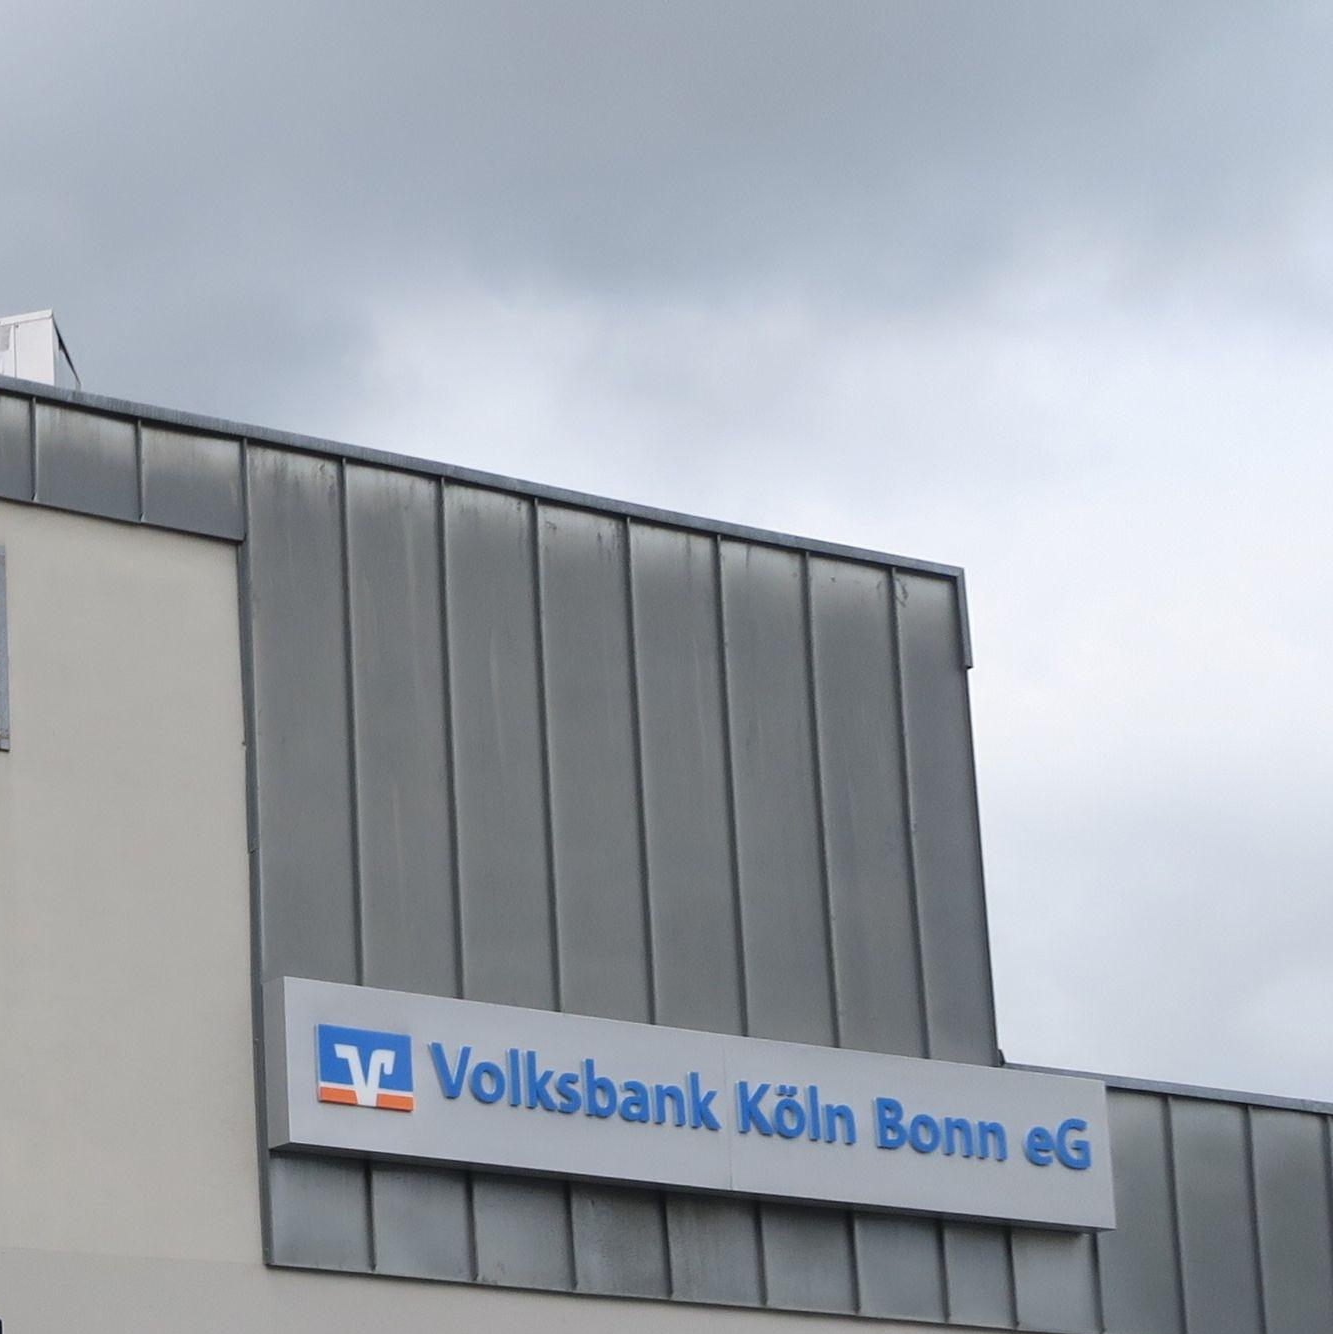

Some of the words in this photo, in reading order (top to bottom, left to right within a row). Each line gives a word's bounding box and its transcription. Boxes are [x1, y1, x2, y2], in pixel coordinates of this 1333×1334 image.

[427, 1041, 721, 1132] Volksbank
[736, 1080, 856, 1145] Köln
[873, 1096, 1008, 1162] Bonn
[1024, 1117, 1093, 1171] eG
